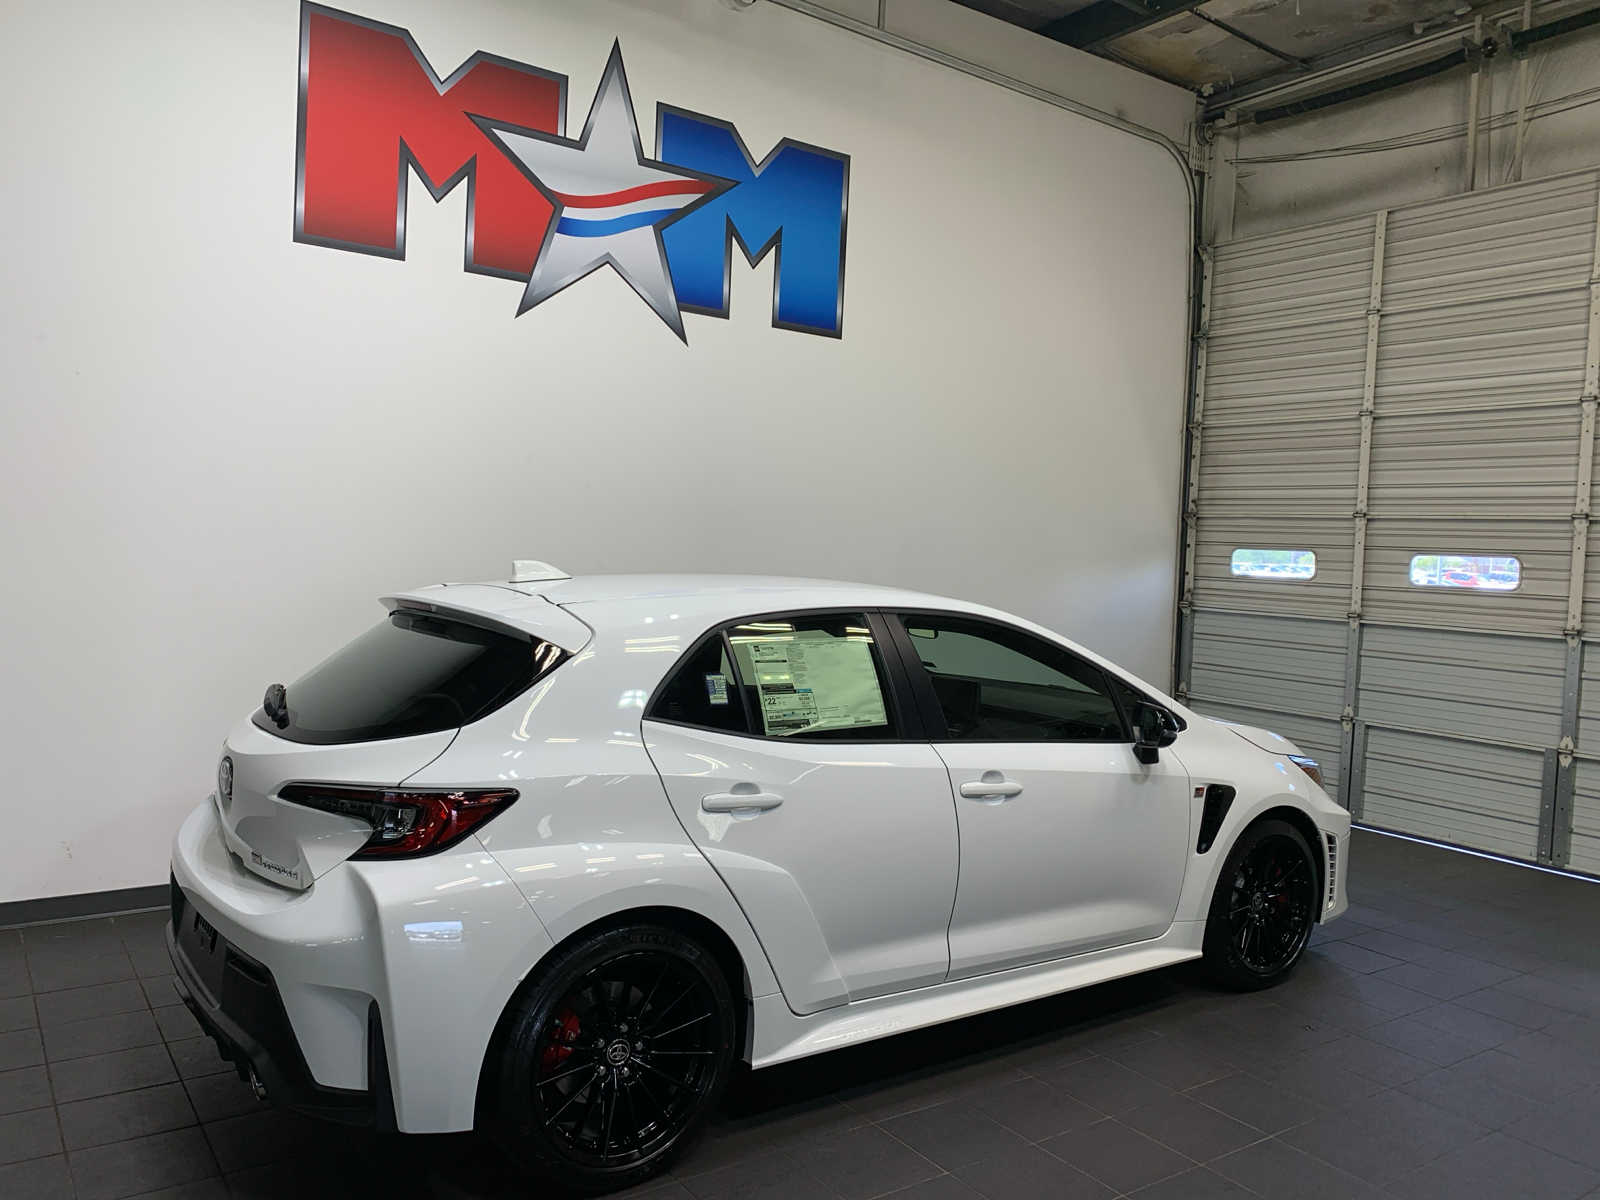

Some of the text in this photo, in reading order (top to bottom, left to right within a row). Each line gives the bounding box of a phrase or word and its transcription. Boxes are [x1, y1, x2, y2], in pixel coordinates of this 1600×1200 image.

[293, 1, 851, 339] M M
[767, 697, 777, 705] 22
